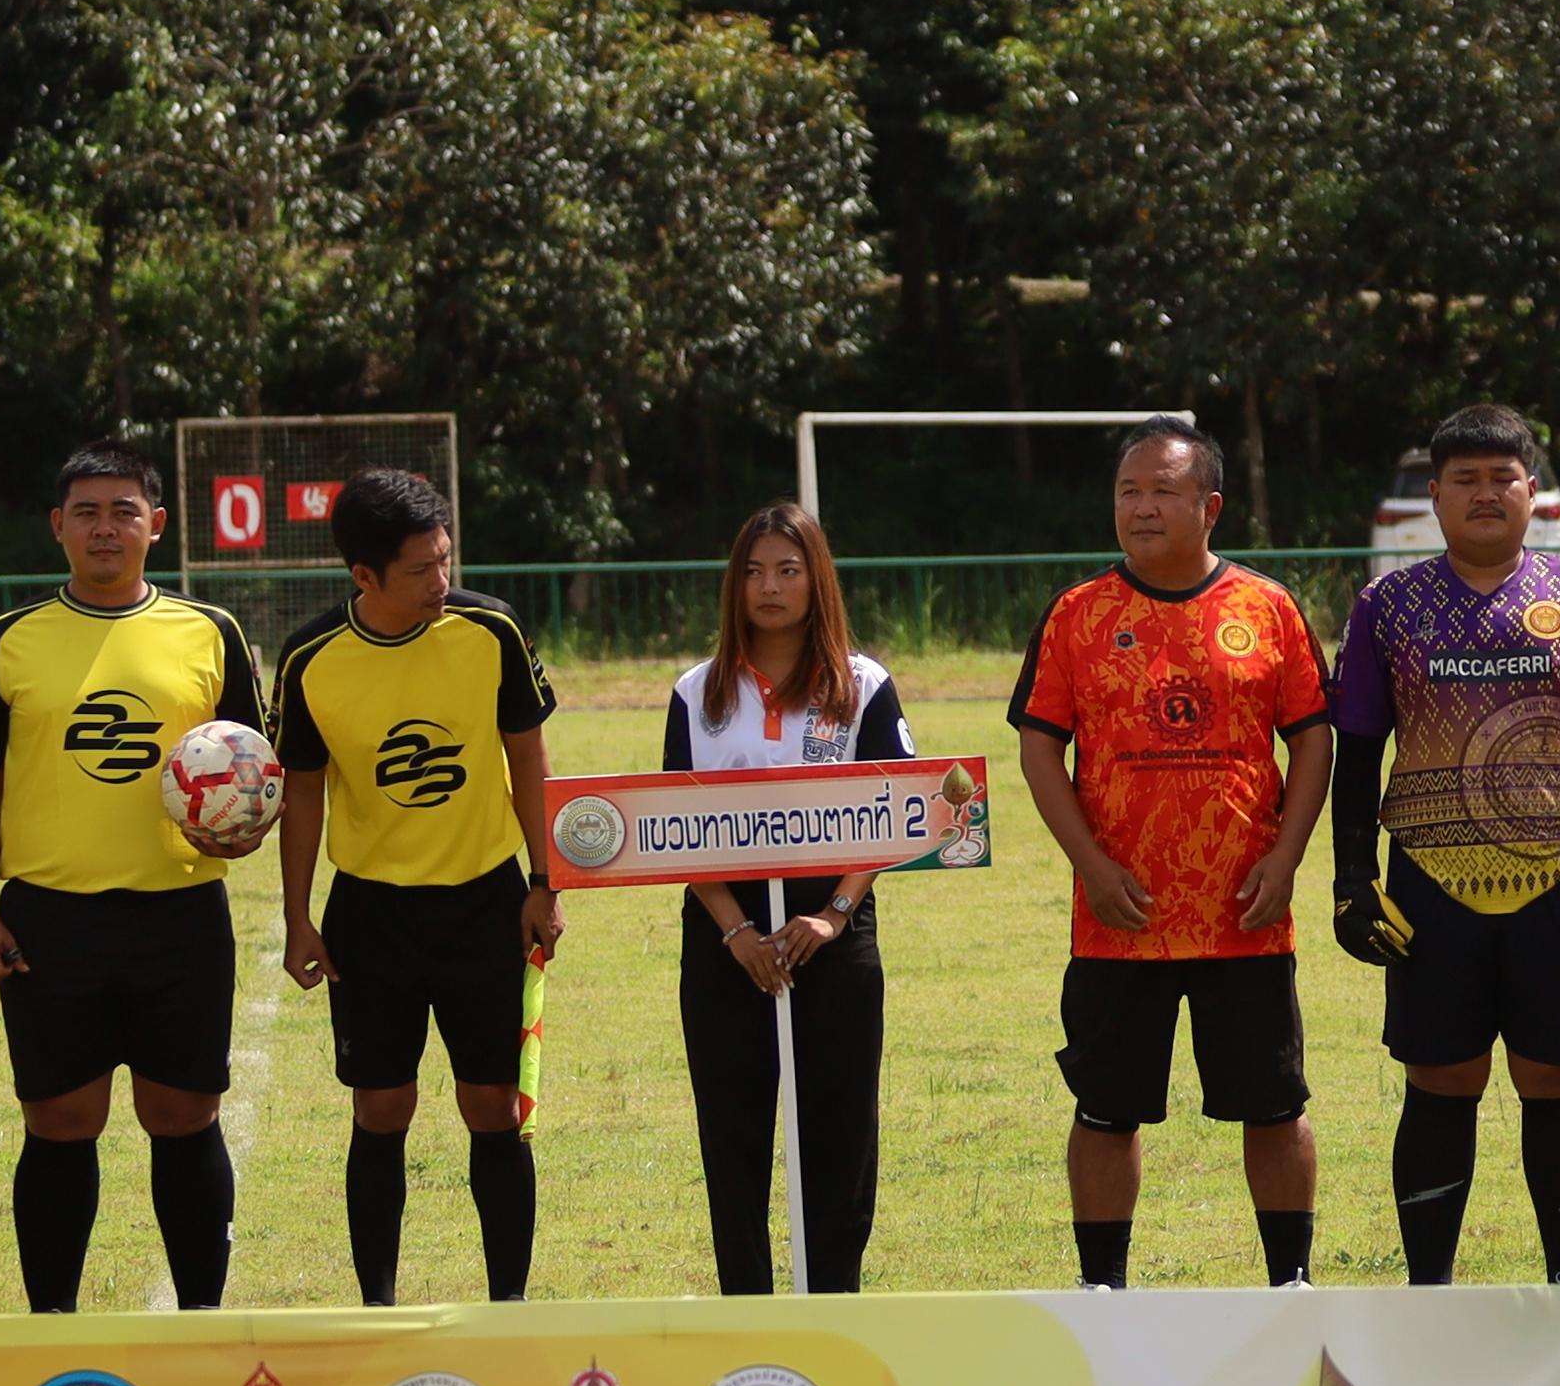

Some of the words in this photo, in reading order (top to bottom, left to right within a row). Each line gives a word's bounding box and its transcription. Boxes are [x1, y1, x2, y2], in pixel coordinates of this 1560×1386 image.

[1428, 653, 1552, 678] MACCAFERRI
[638, 781, 893, 854] แขวงทางหลวงตากที่
[904, 796, 928, 839] 2
